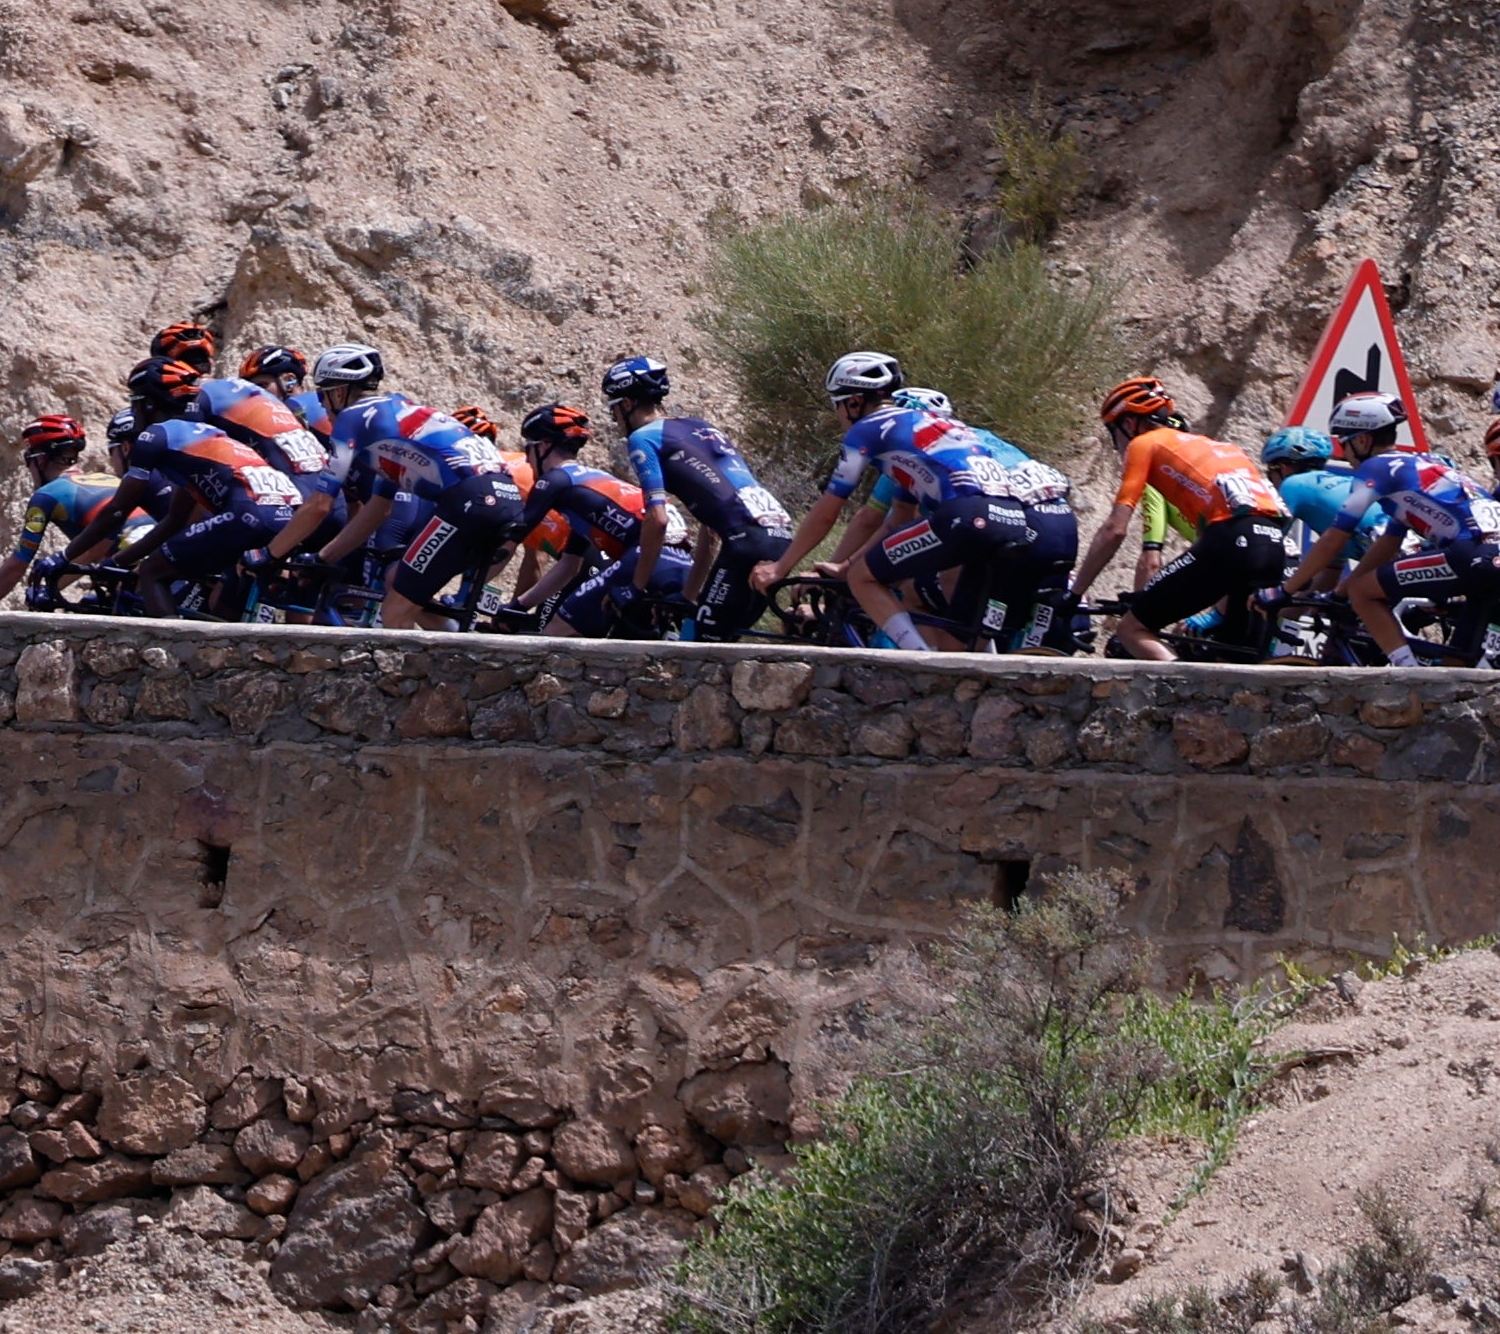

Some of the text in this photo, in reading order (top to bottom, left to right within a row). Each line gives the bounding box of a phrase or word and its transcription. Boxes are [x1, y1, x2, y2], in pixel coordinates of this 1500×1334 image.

[377, 443, 431, 468] QUICK-STEP
[683, 455, 721, 485] FACTOR
[976, 460, 1002, 482] 38
[184, 511, 235, 539] Jayco
[411, 524, 453, 574] SOUDAL
[887, 534, 940, 561] SOUDAL
[575, 559, 621, 598] Jayco
[706, 567, 728, 605] PREMIER
[1398, 565, 1451, 583] SOUDAL
[482, 593, 499, 612] 36
[714, 582, 731, 606] TECH
[259, 605, 275, 624] 42
[1035, 606, 1052, 628] 195
